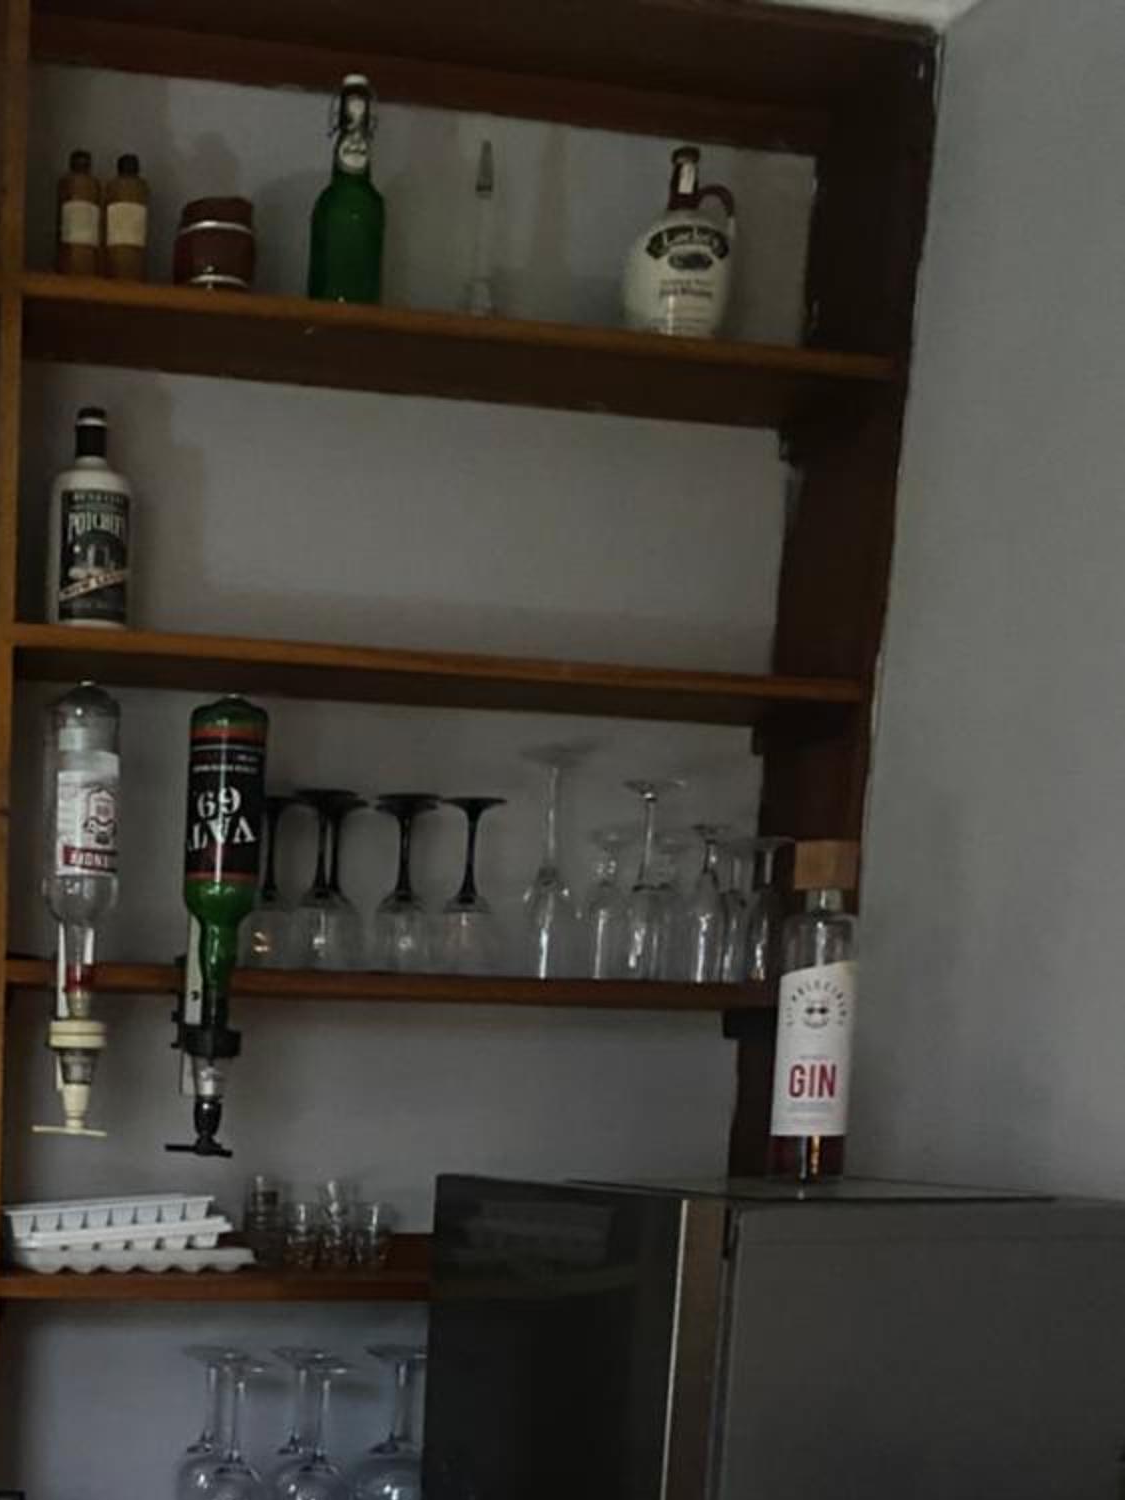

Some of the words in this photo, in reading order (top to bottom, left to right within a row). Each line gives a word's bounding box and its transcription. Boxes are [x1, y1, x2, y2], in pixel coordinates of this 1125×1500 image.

[197, 786, 241, 819] 69
[188, 816, 256, 852] VAT
[789, 1063, 837, 1098] GIN
